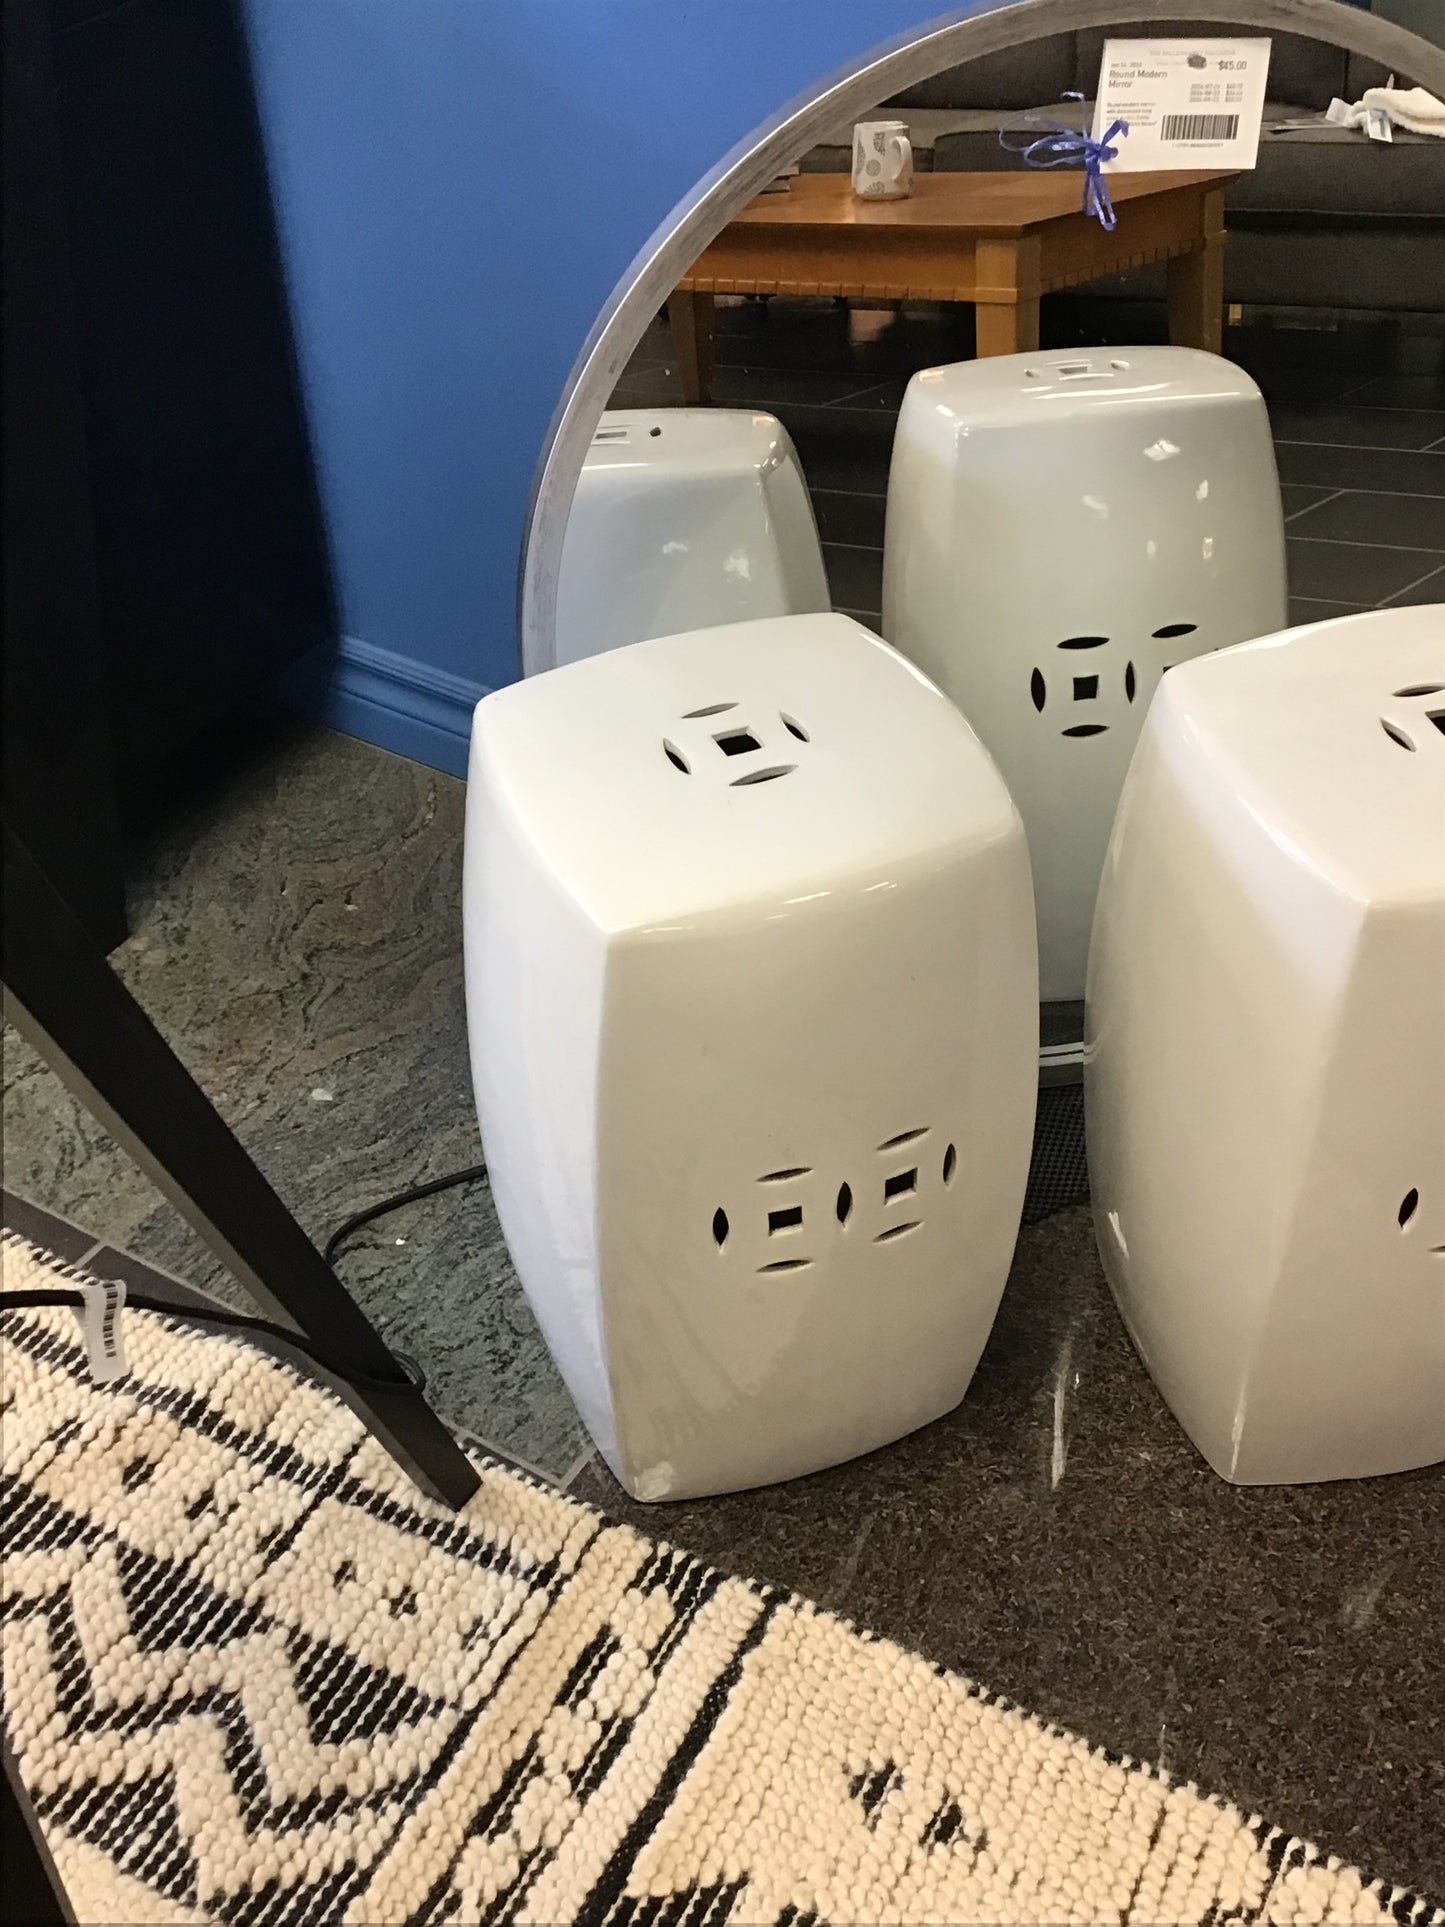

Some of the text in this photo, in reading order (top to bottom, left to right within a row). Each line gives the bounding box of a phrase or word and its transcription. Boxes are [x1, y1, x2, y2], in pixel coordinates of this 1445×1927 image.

[1218, 60, 1248, 71] $45.00
[1109, 70, 1168, 79] Round Modern
[1108, 80, 1133, 88] Mirror
